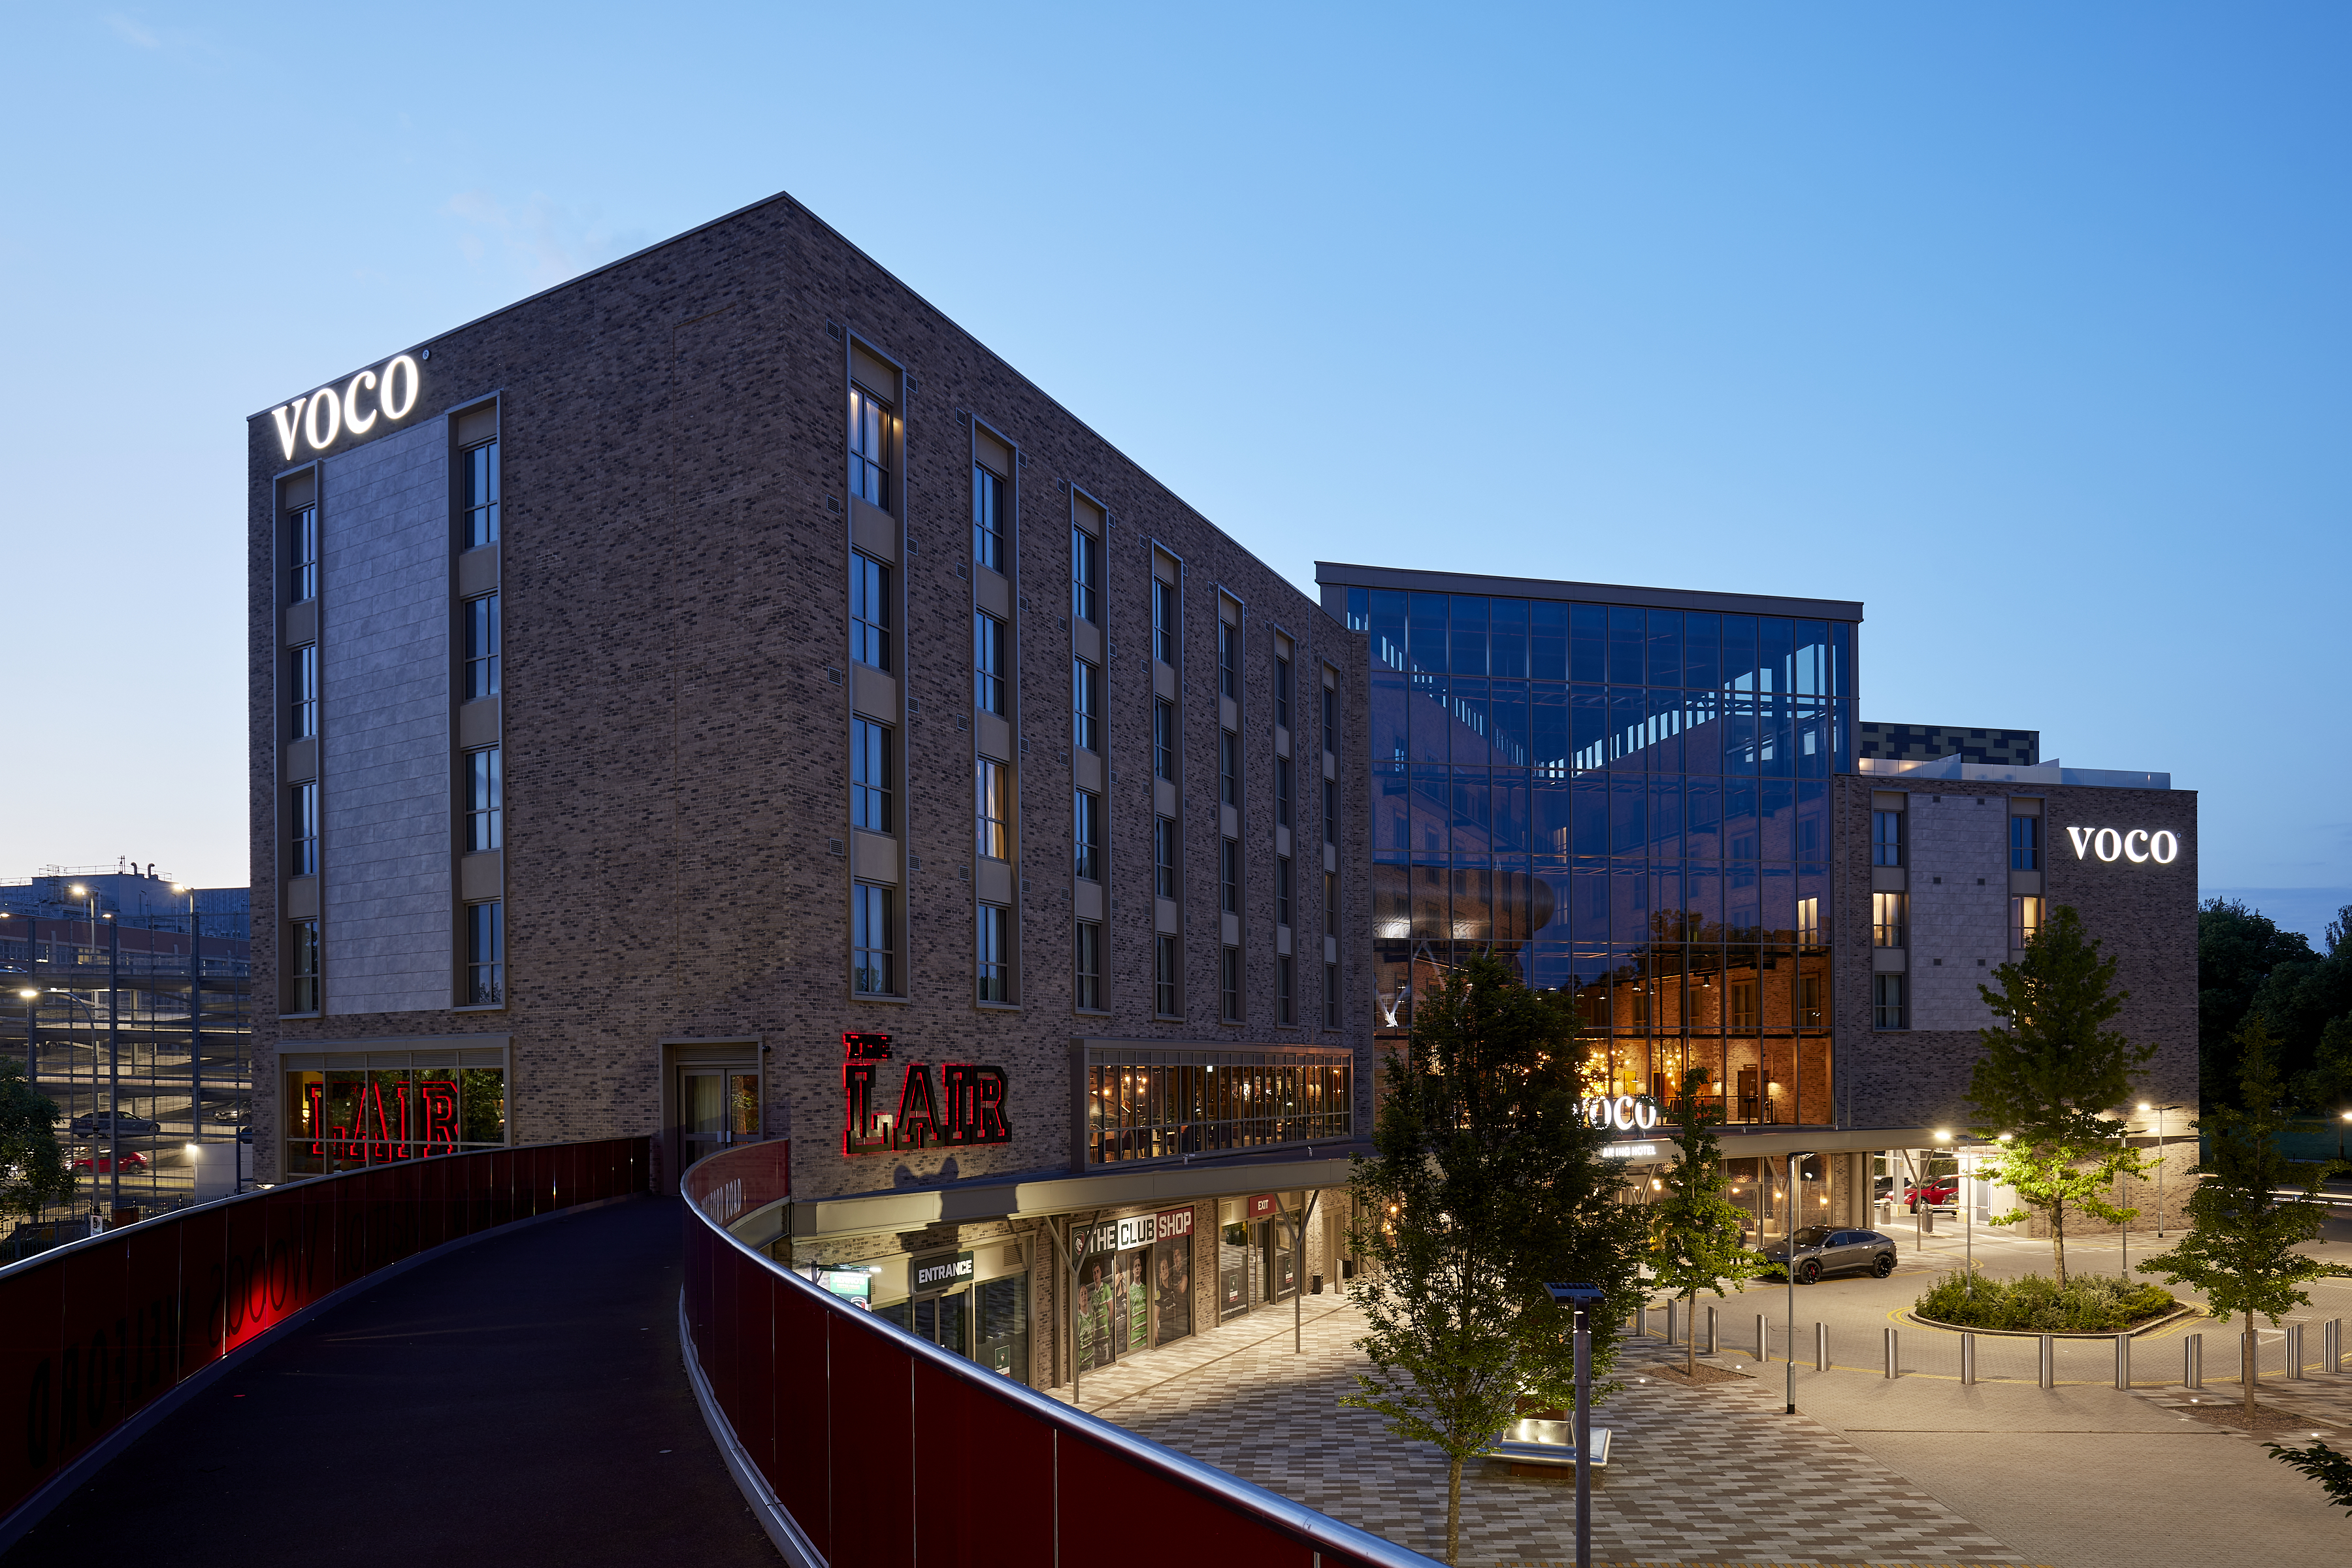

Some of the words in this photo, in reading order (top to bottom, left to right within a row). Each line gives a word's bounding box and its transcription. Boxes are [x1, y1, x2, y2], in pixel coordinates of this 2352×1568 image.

[309, 1081, 459, 1163] LAIR
[843, 1064, 1012, 1154] LAIR
[1603, 1148, 1614, 1158] AN
[1616, 1147, 1630, 1157] IHG
[1631, 1146, 1657, 1156] HOTEL
[725, 1178, 742, 1220] ROAD
[1258, 1199, 1269, 1211] EXIT
[1086, 1225, 1116, 1254] THE
[1120, 1218, 1154, 1246] CLUB
[1158, 1211, 1192, 1239] SHOP
[919, 1259, 972, 1284] ENTRANCE
